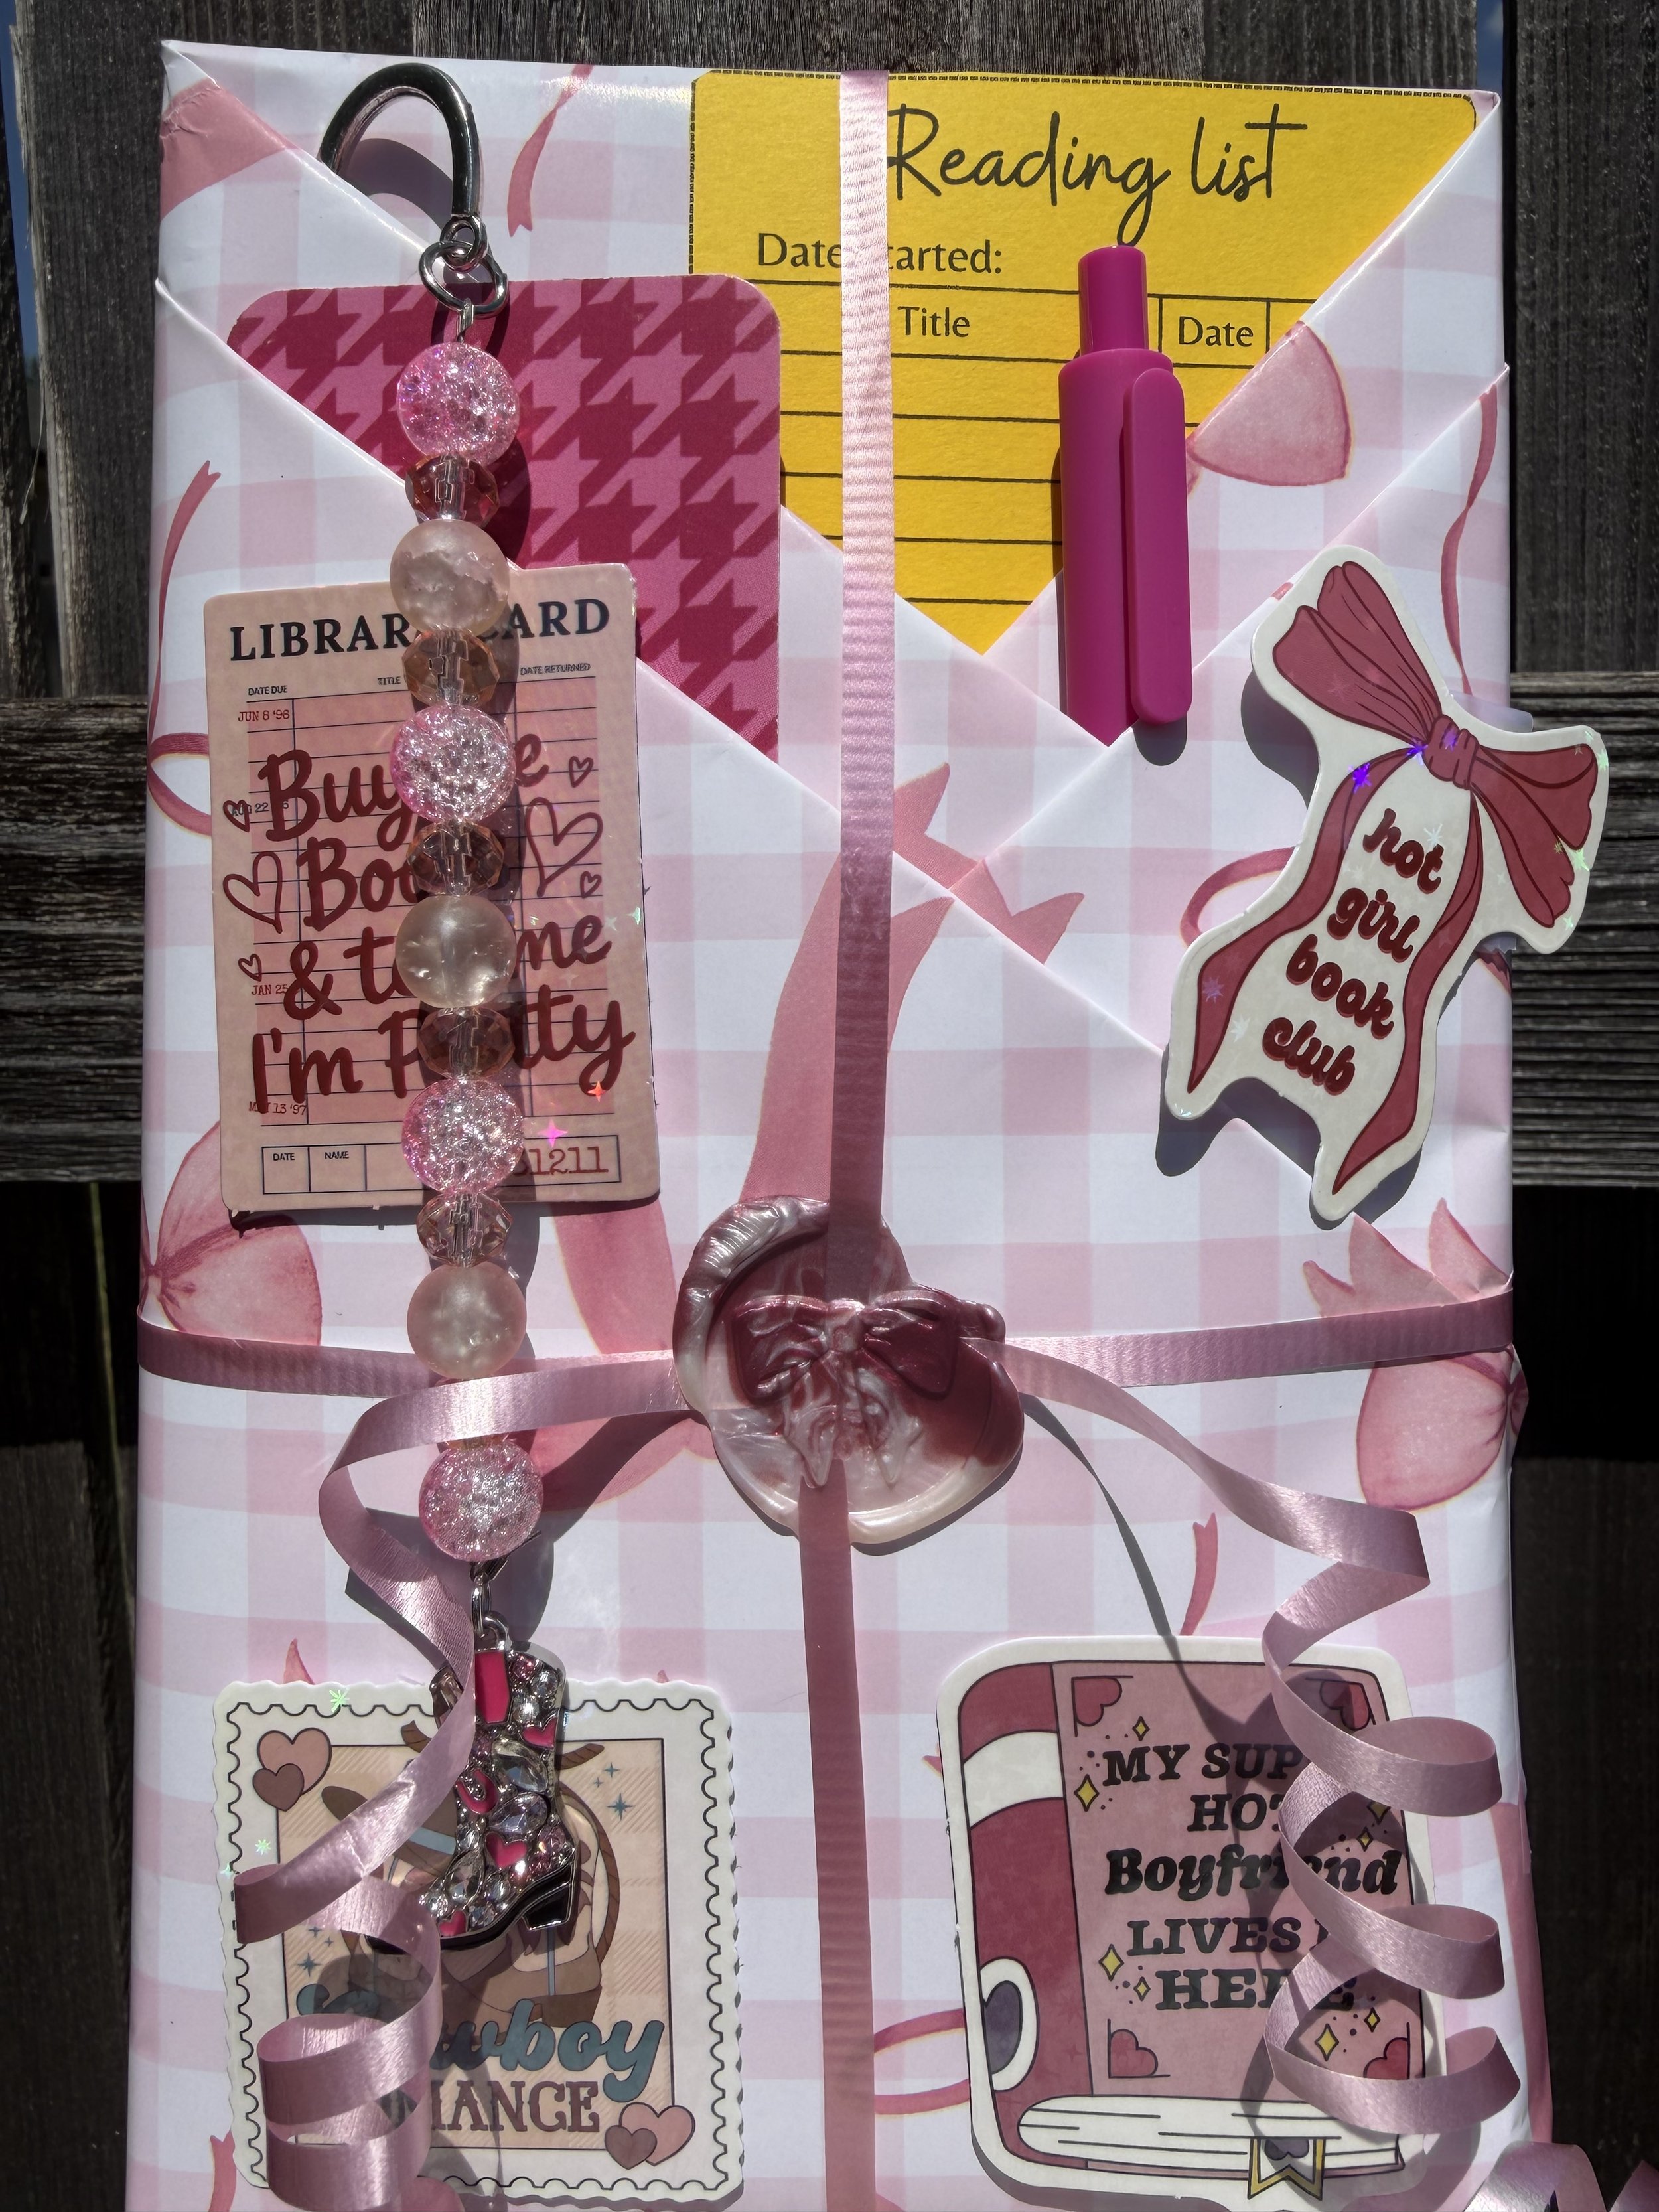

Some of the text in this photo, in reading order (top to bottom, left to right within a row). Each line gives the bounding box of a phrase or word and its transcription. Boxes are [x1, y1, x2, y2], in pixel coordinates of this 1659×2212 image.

[887, 102, 1308, 248] Reading list
[758, 232, 1002, 275] Date arted:
[897, 305, 970, 338] Title
[1179, 316, 1254, 348] Date
[231, 599, 610, 662] LIBRAR ARD
[248, 685, 288, 696] DATE DUE
[378, 676, 401, 685] TITLE
[520, 666, 543, 676] DATE
[238, 711, 259, 722] JUN
[263, 710, 270, 720] 8
[255, 802, 269, 814] 22
[1362, 808, 1444, 894] hot
[1327, 887, 1420, 962] girl
[252, 984, 272, 995] JAN
[283, 941, 343, 1021] &
[1286, 934, 1394, 1040] book
[378, 984, 636, 1099] Ptty
[1262, 1017, 1356, 1096] club
[272, 1103, 287, 1112] 13
[1102, 1743, 1190, 1787] MY
[1126, 1917, 1301, 1956] LIVES
